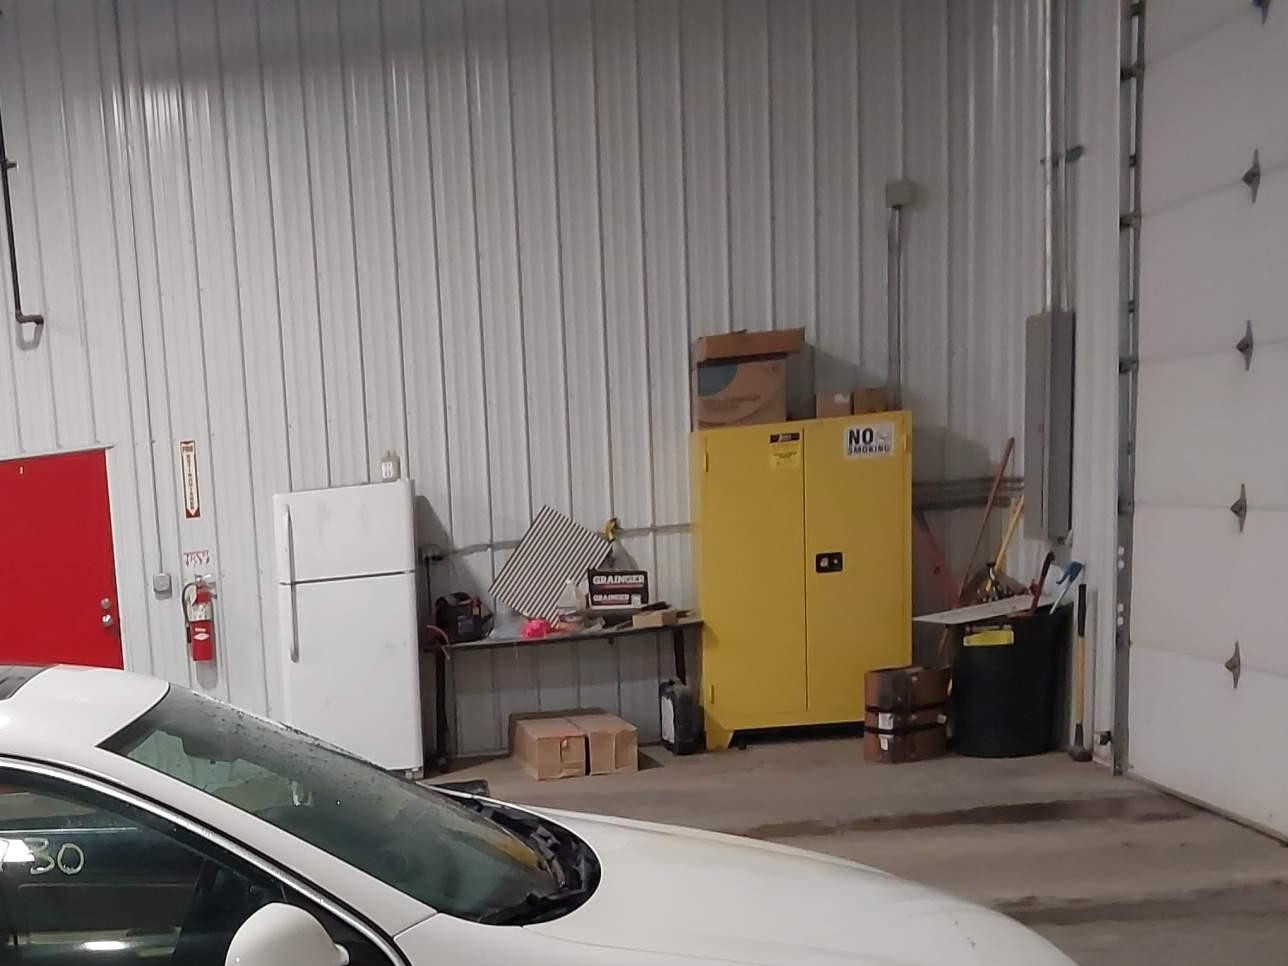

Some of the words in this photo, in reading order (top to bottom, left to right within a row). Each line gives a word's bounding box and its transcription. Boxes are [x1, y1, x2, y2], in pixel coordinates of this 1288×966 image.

[848, 428, 875, 446] NO
[847, 443, 890, 456] SMOKING
[592, 574, 645, 585] GRAINGER
